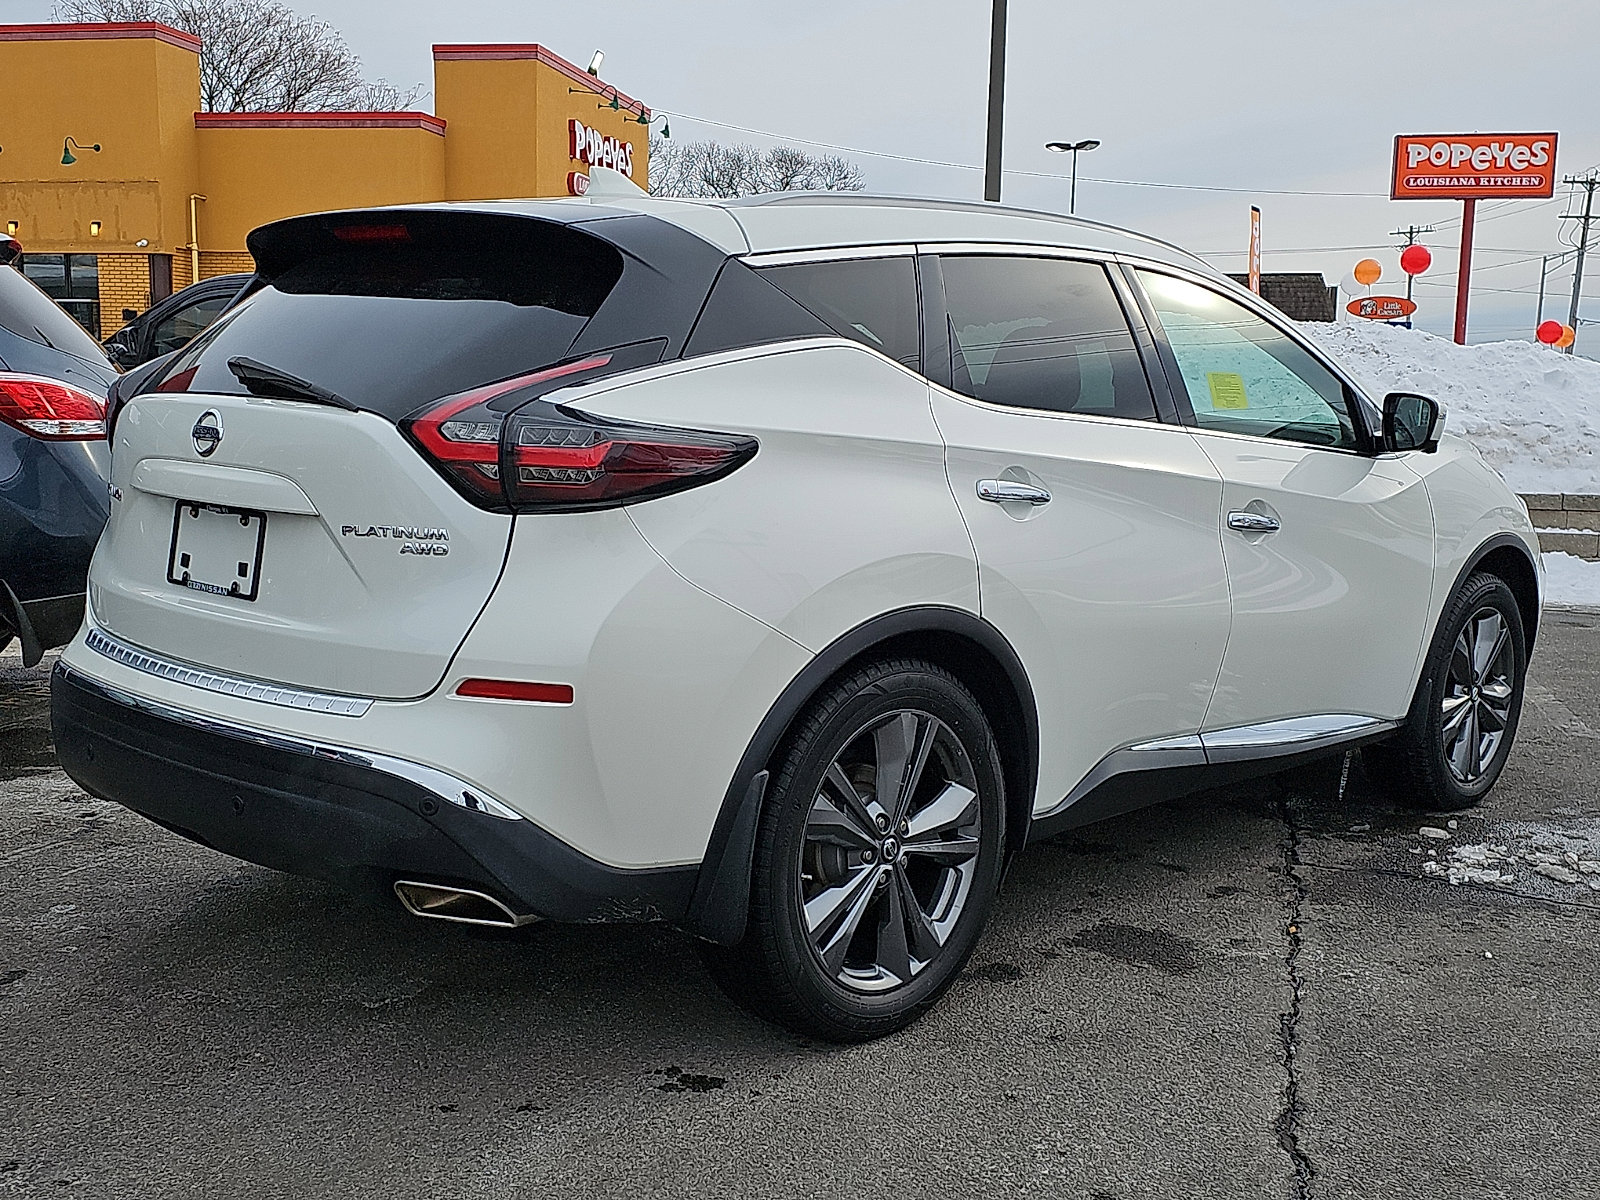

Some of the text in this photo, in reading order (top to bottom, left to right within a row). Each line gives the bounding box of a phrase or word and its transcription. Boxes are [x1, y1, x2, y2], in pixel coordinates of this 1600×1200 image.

[1407, 141, 1550, 170] POPeYeS
[1408, 176, 1541, 187] LOUISIANA KITCHEN
[1383, 301, 1402, 310] Little
[341, 525, 449, 540] PLATINUM
[399, 542, 449, 556] AWD
[201, 584, 228, 596] NISSAN
